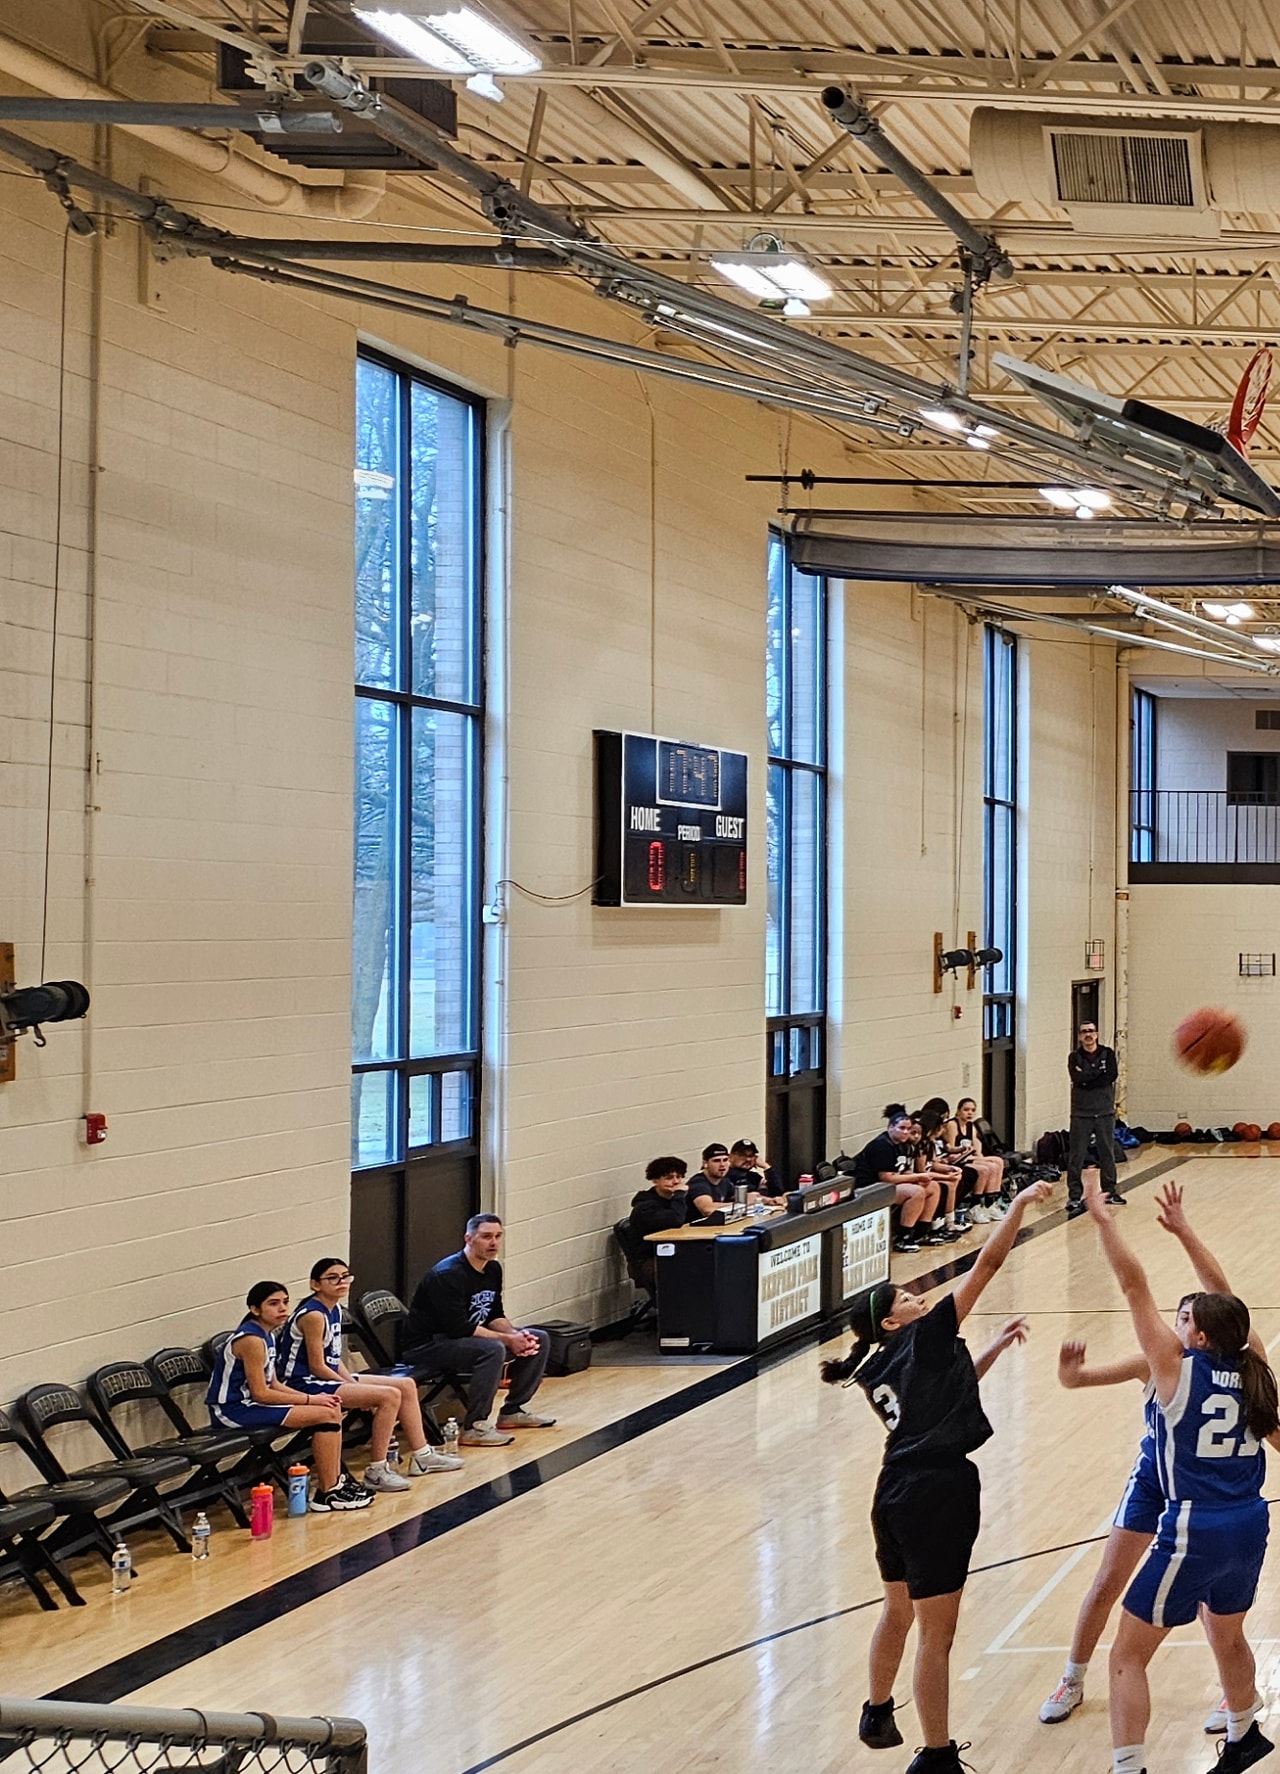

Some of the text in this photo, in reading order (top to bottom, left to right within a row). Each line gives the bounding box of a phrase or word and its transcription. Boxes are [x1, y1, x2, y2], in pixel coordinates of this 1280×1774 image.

[631, 806, 661, 831] HOME
[715, 815, 745, 839] GUEST
[677, 825, 701, 841] PERIOD
[650, 841, 664, 891] 0
[770, 1241, 811, 1268] WELCOME TO
[158, 1355, 204, 1382] BEDFORD
[101, 1369, 152, 1398] BEDFORD
[873, 1384, 901, 1431] 3
